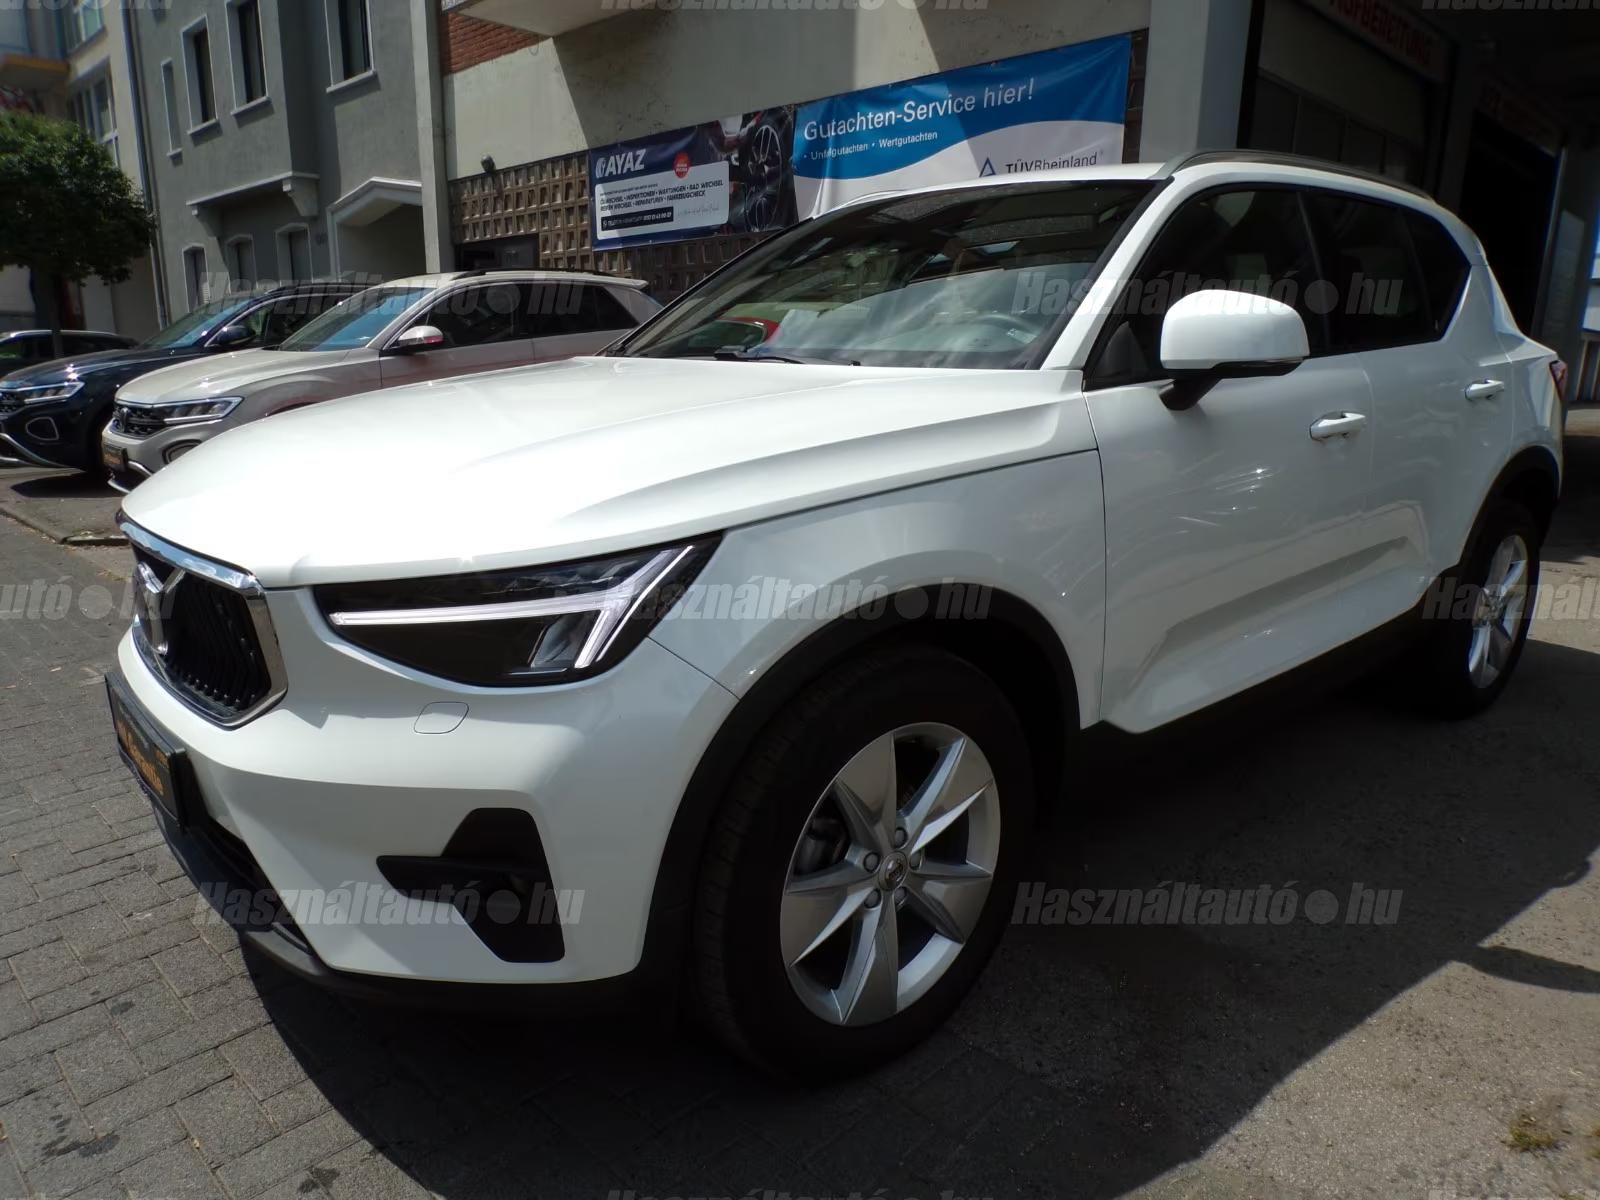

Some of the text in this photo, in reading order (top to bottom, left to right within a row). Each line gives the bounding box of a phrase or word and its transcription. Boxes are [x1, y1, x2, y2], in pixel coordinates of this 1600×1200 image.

[804, 78, 1035, 141] Gutachten-Service hier!
[878, 130, 939, 149] Wertgutachten
